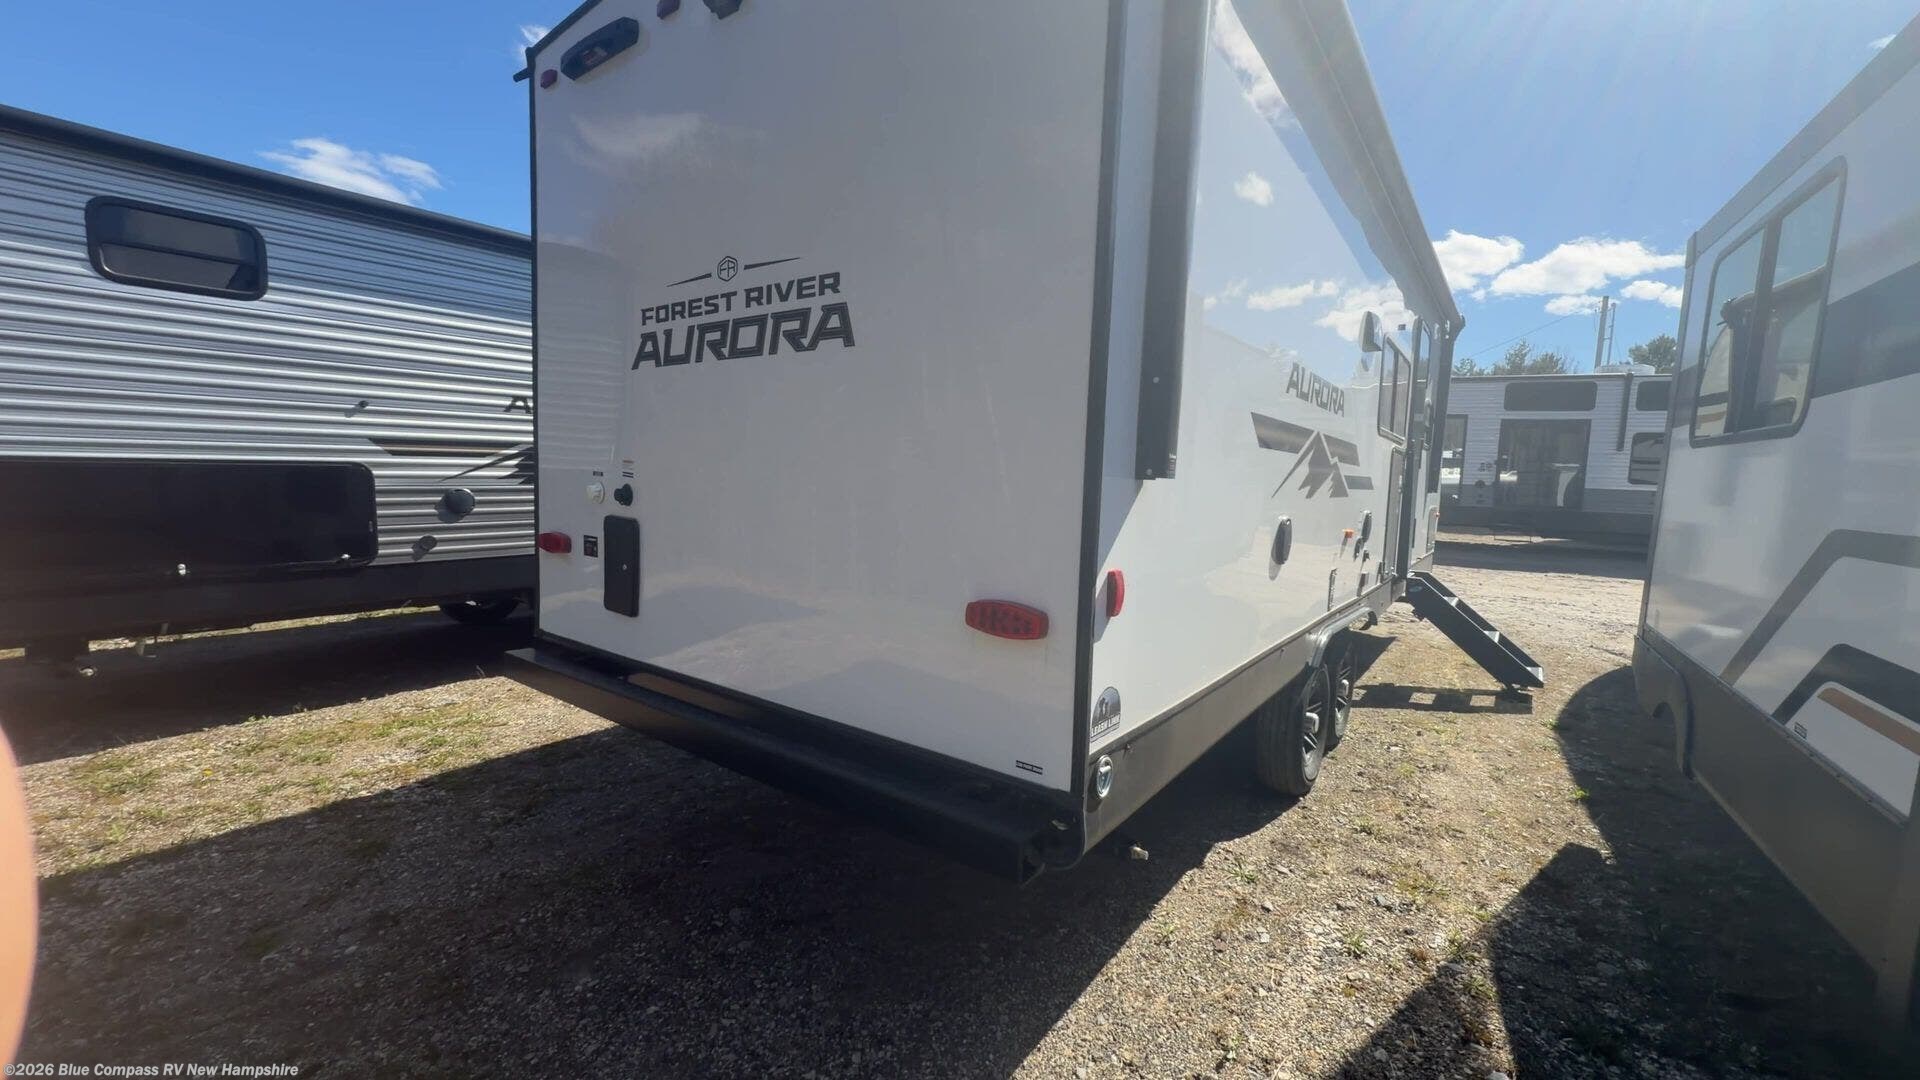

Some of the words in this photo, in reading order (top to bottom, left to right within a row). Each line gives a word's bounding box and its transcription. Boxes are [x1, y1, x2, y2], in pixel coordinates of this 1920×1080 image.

[641, 291, 738, 326] FOREST
[743, 271, 841, 308] RIVER
[631, 301, 856, 370] AURORA
[1285, 361, 1345, 418] AURORA
